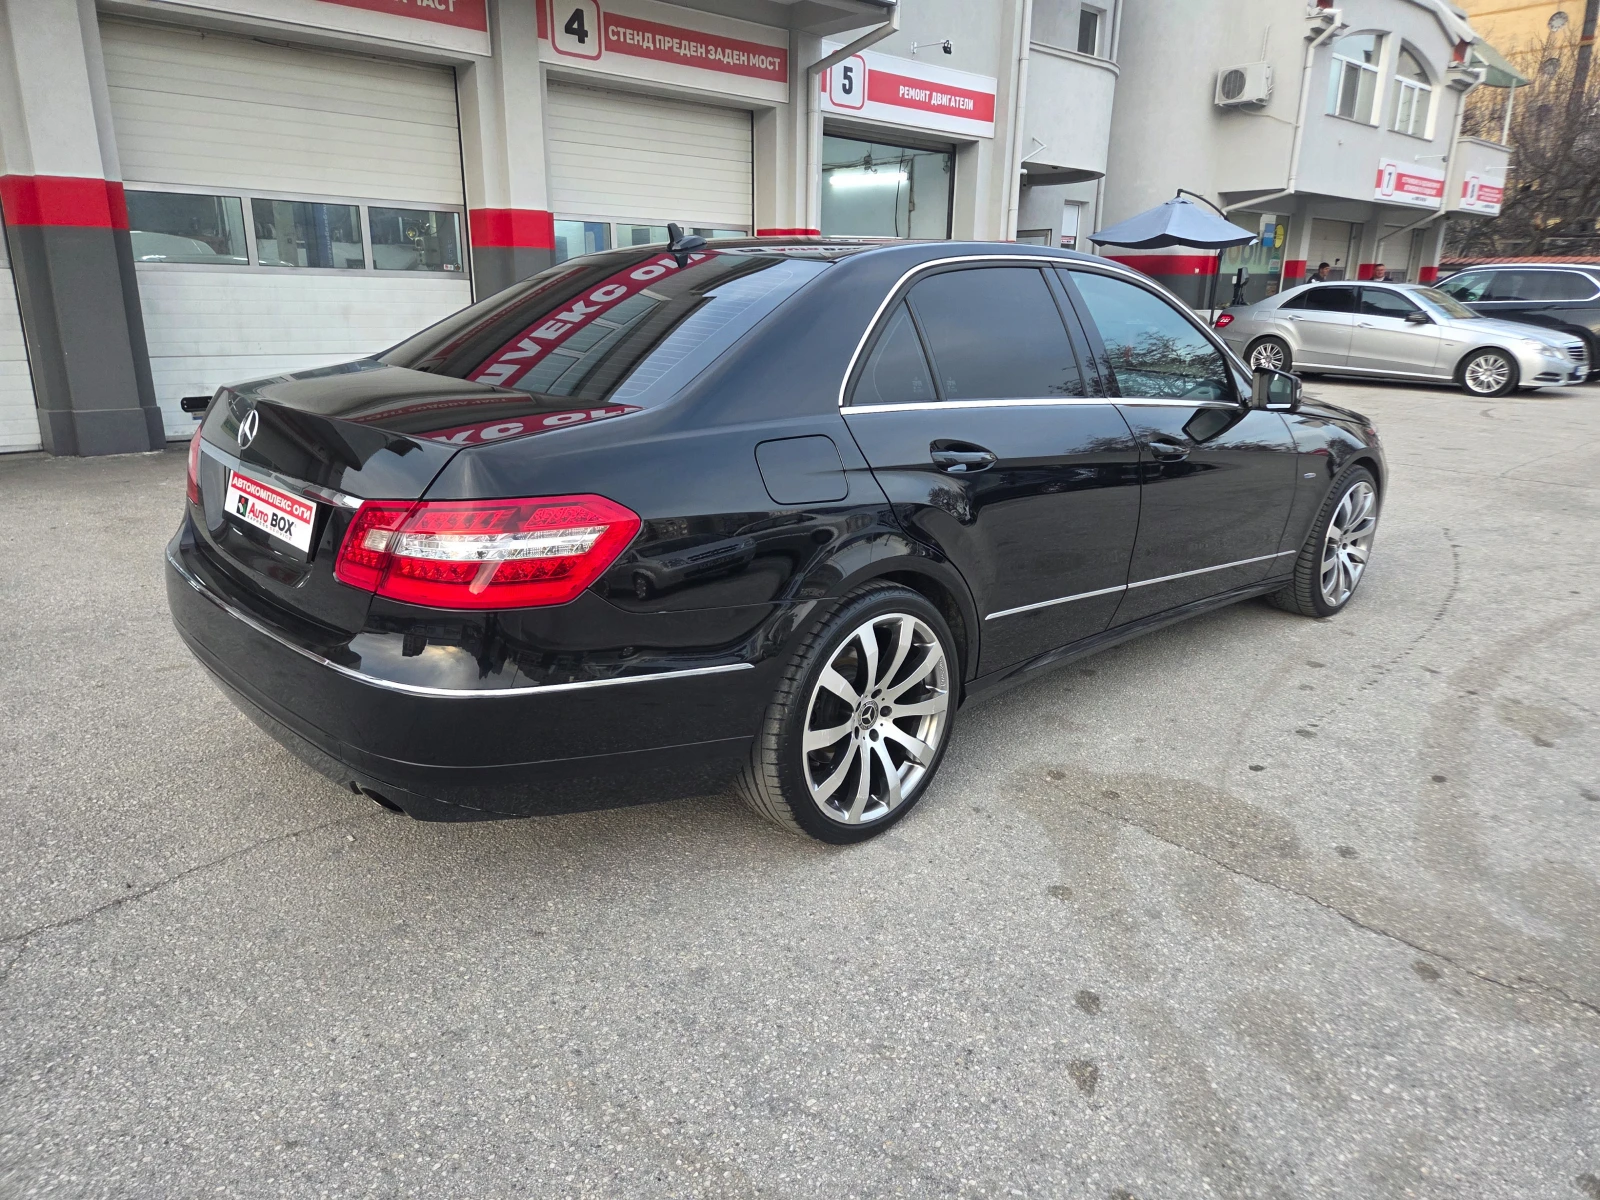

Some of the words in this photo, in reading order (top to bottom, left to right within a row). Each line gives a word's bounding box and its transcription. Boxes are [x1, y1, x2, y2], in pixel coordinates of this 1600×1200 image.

[564, 8, 588, 44] 4
[608, 25, 654, 50] СТЕНД
[655, 35, 706, 58] ПРЕДЕН
[707, 45, 748, 66] ЗАДЕН
[749, 54, 781, 71] МОСТ
[842, 65, 854, 95] 5
[899, 85, 931, 103] РЕМОНТ
[931, 91, 974, 111] ДВИГАТЕЛИ
[232, 476, 292, 511] АВТОКОМПЛЕКС
[293, 504, 311, 521] ОГИ
[270, 512, 294, 537] BOX
